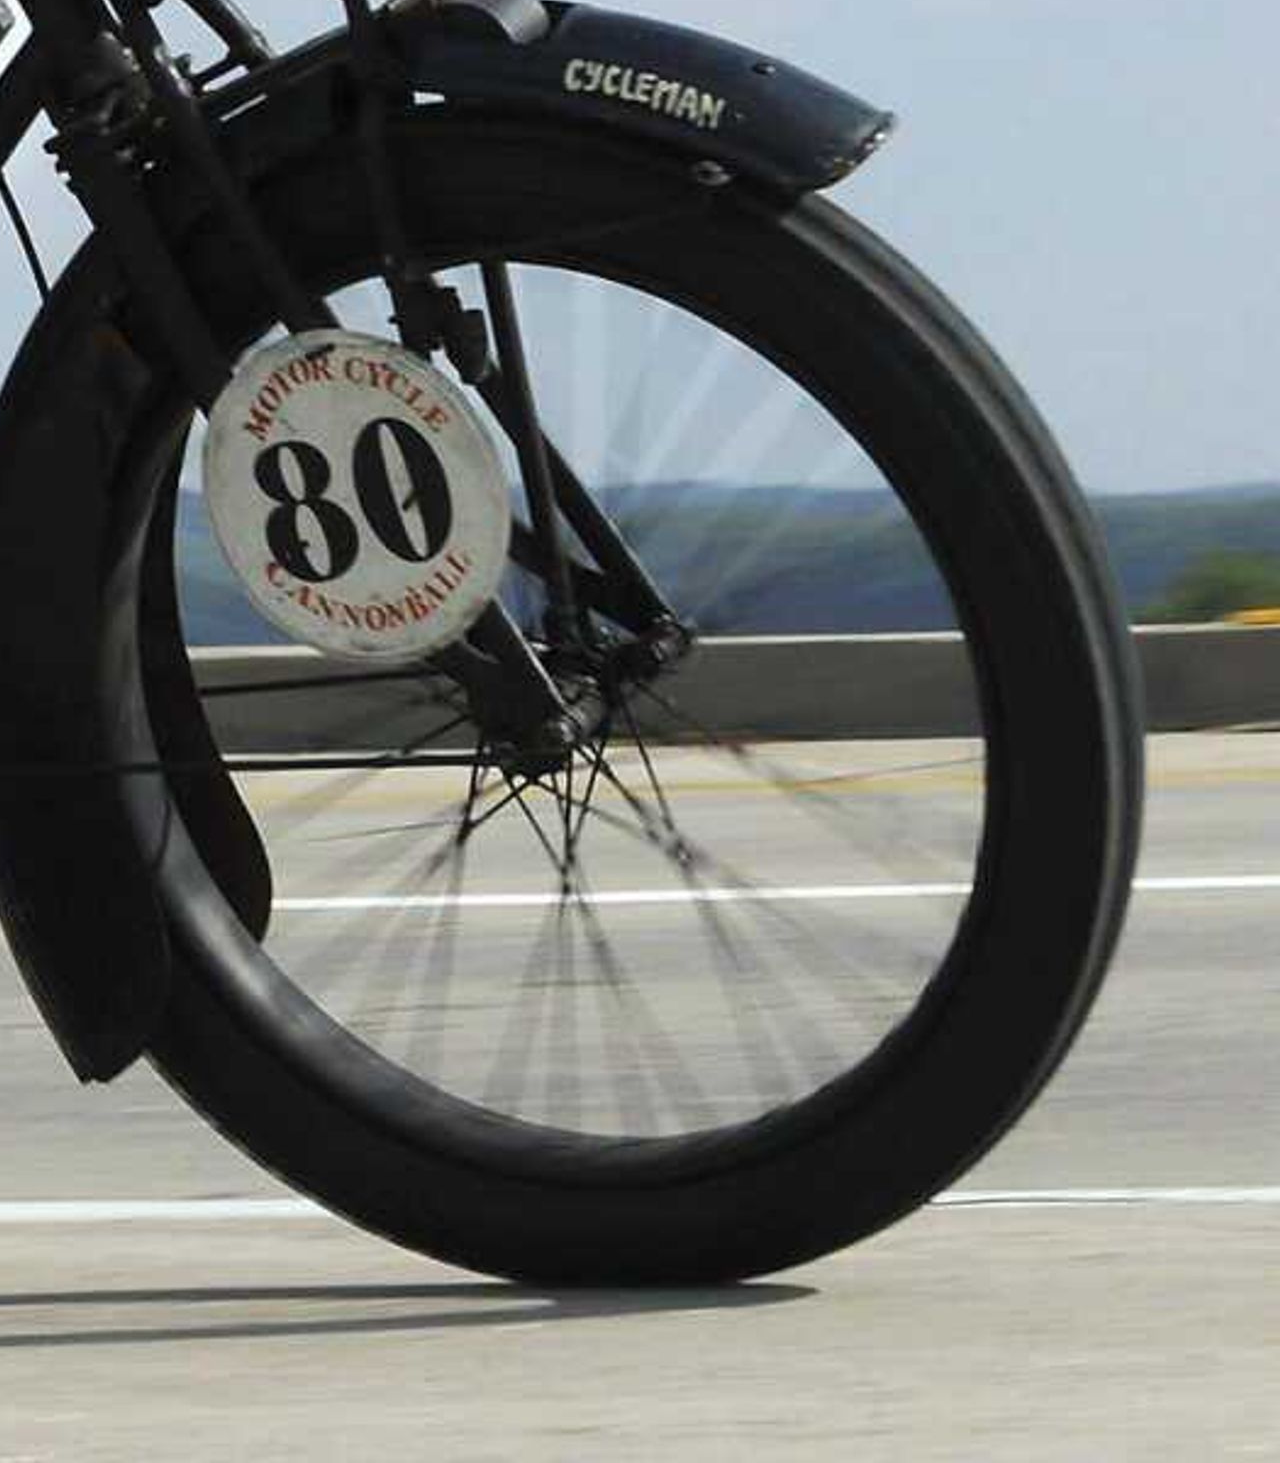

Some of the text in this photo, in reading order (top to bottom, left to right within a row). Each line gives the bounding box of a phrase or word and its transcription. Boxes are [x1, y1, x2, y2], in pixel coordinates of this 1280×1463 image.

[564, 58, 726, 129] CYCLEMAN
[245, 353, 451, 442] MOTOR CYCLE
[253, 417, 452, 582] 80
[266, 548, 472, 632] CANNONBALL
